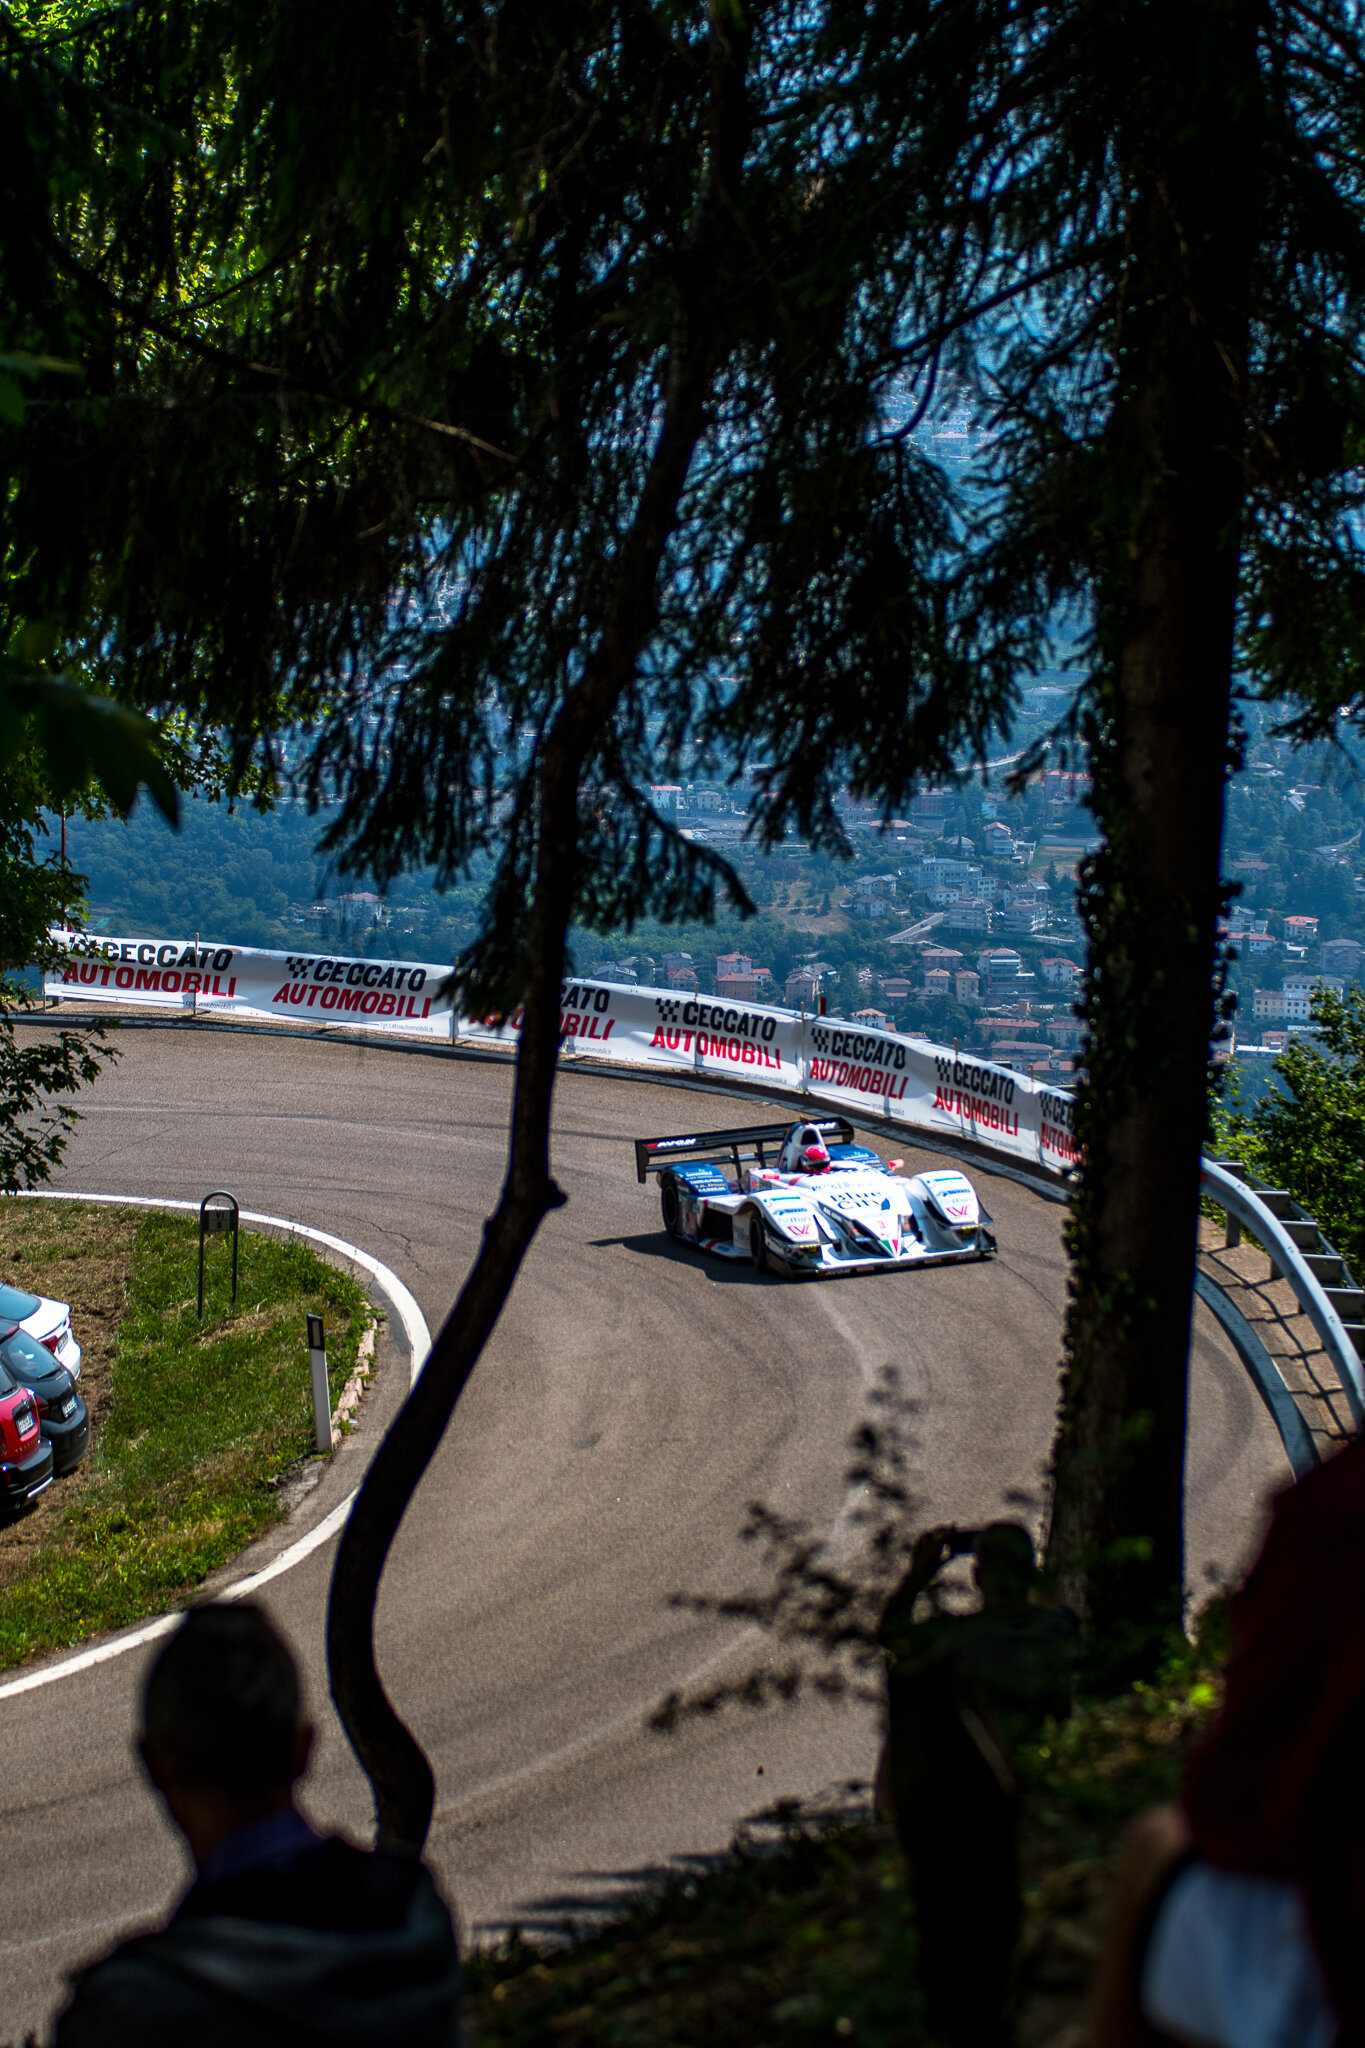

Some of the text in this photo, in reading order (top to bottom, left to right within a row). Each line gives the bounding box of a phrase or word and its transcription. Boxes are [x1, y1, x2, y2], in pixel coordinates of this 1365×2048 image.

[101, 941, 233, 972] CECCATO
[313, 959, 427, 992] CECCATO
[61, 961, 237, 998] AUTOMOBILI
[272, 982, 432, 1019] AUTOMOBILI
[682, 1000, 777, 1042] CECCATO
[648, 1025, 782, 1070] AUTOMOBILI
[831, 1030, 906, 1070] CECCATO
[809, 1056, 909, 1100] AUTOMOBILI
[952, 1060, 1015, 1105] CECCATO
[932, 1085, 1018, 1137] AUTOMOBILI
[829, 1191, 881, 1202] Blue
